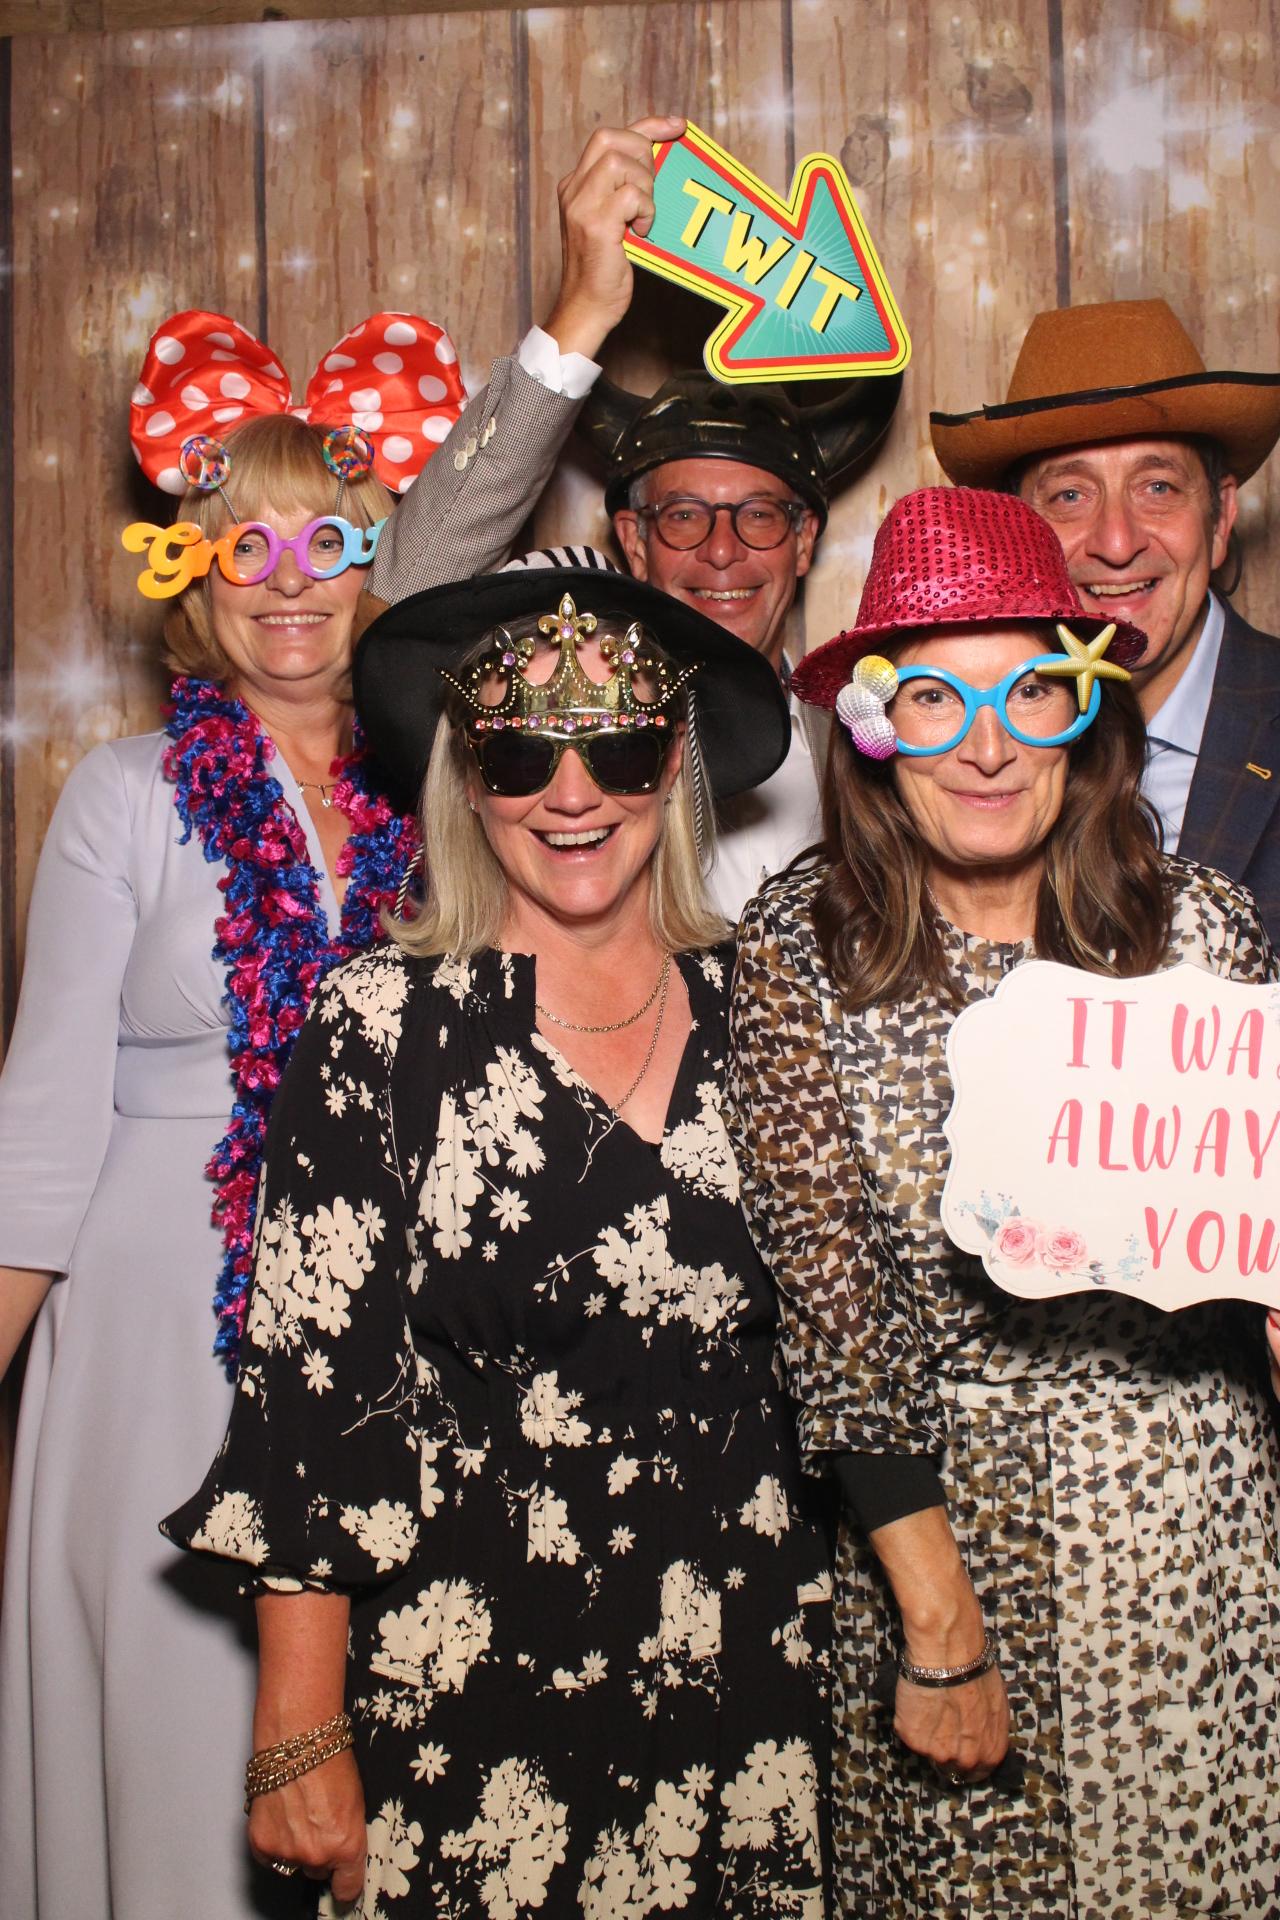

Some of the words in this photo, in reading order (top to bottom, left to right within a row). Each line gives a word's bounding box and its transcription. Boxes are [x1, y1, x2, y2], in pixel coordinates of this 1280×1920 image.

[680, 177, 864, 335] TWIT
[1066, 997, 1138, 1070] IT
[1171, 1003, 1280, 1080] WA
